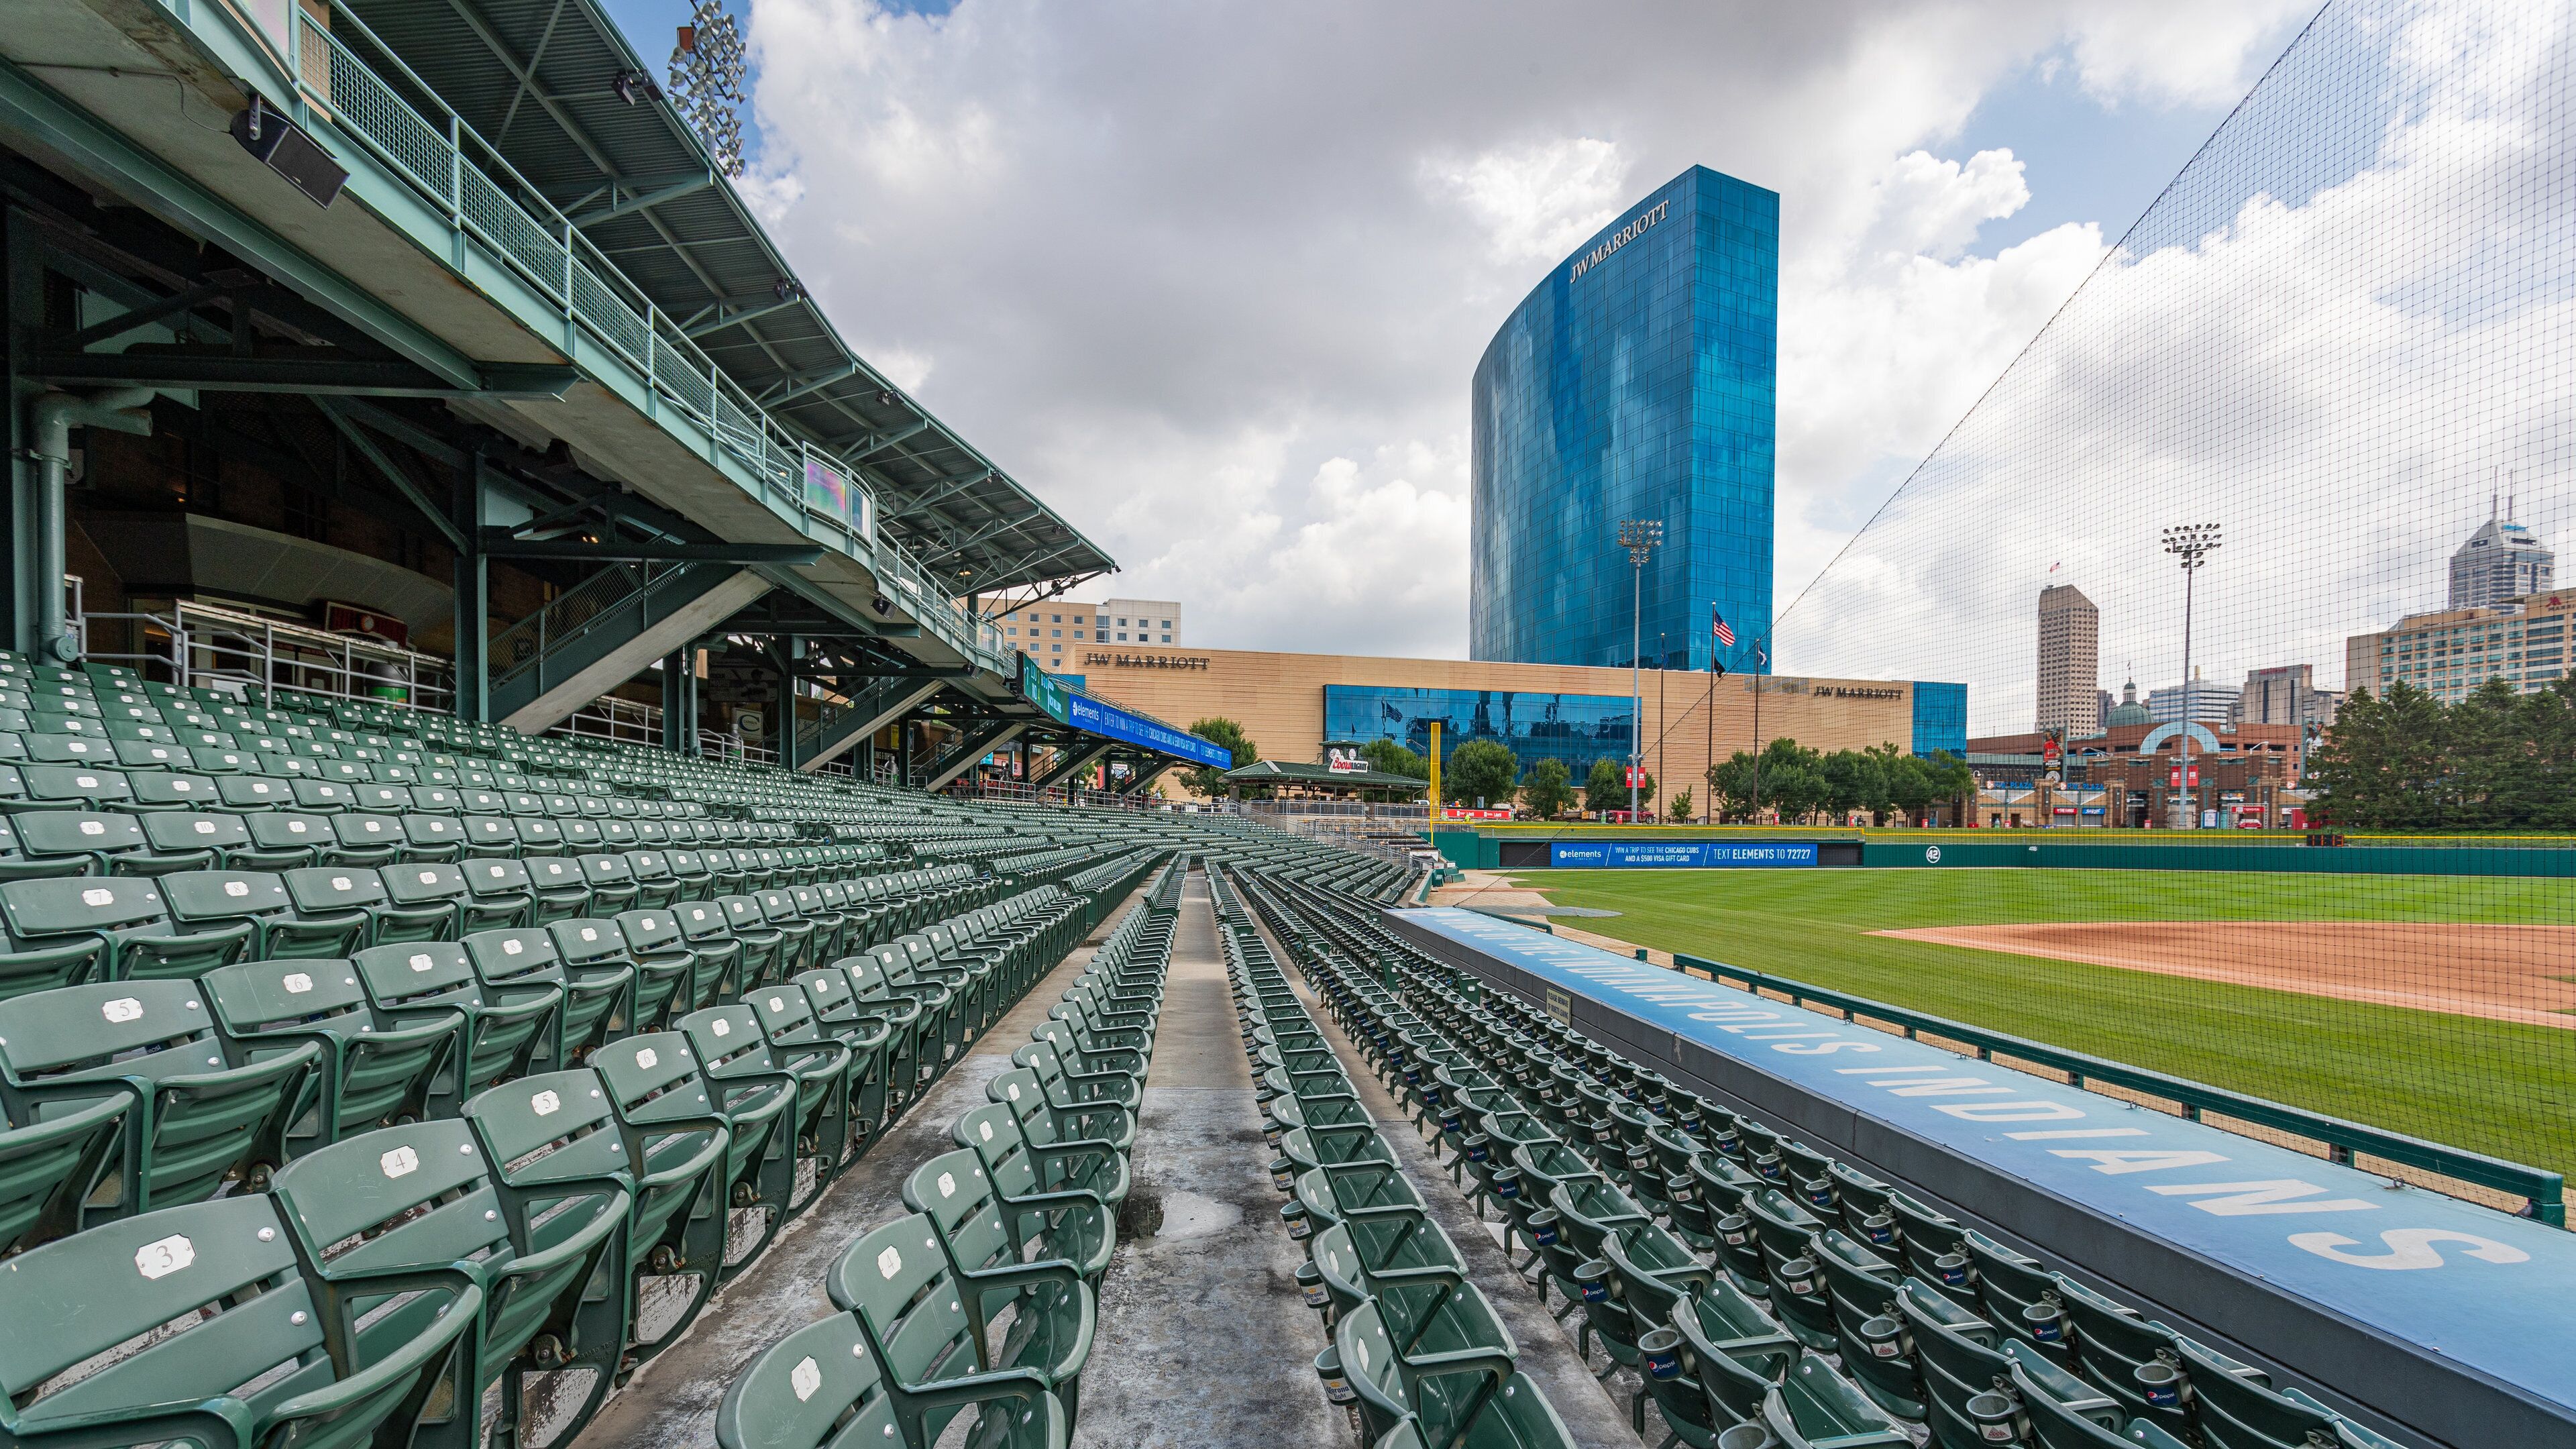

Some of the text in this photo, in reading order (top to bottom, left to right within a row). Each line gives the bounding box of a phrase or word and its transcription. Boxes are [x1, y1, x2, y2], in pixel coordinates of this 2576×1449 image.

[1570, 200, 1670, 284] JW MARRIOTT
[1084, 653, 1210, 669] JW MARRIOTT
[1814, 686, 1903, 700] JW MARRIOTT
[1077, 702, 1099, 721] elements
[1332, 757, 1367, 770] Coors LIGHT
[88, 824, 96, 833] 9
[200, 823, 210, 832] 10
[1567, 849, 1601, 857] elements
[1713, 849, 1811, 859] TEXT ELEMENTS TO 72727
[1927, 849, 1938, 859] 42
[1641, 855, 1653, 863] $500
[424, 873, 433, 882] 10
[338, 879, 345, 888] 9
[233, 884, 241, 894] 8
[94, 892, 101, 902] 7
[510, 942, 517, 951] 8
[1499, 942, 1582, 956] THE
[418, 957, 425, 968] 7
[294, 977, 303, 989] 6
[1548, 991, 1557, 1002] PLEASE
[119, 1002, 130, 1017] 5
[1539, 957, 1882, 1055] INDIANAPOLIS
[718, 1022, 724, 1032] 7
[643, 1051, 651, 1065] 6
[542, 1094, 551, 1109] 5
[395, 1152, 406, 1169] 4
[1835, 1065, 2530, 1271] INDIANS
[943, 1176, 951, 1191] 5
[1289, 1224, 1306, 1232] Corona
[1542, 1231, 1555, 1239] pepsi
[156, 1244, 174, 1269] 3
[886, 1253, 895, 1270] 4
[1305, 1291, 1324, 1299] Corona
[1590, 1287, 1604, 1295] pepsi
[1658, 1360, 1676, 1370] pepsi
[800, 1366, 811, 1390] 3
[1326, 1385, 1350, 1394] Corona
[2159, 1391, 2175, 1399] pepsi
[1988, 1430, 2006, 1438] Coors
